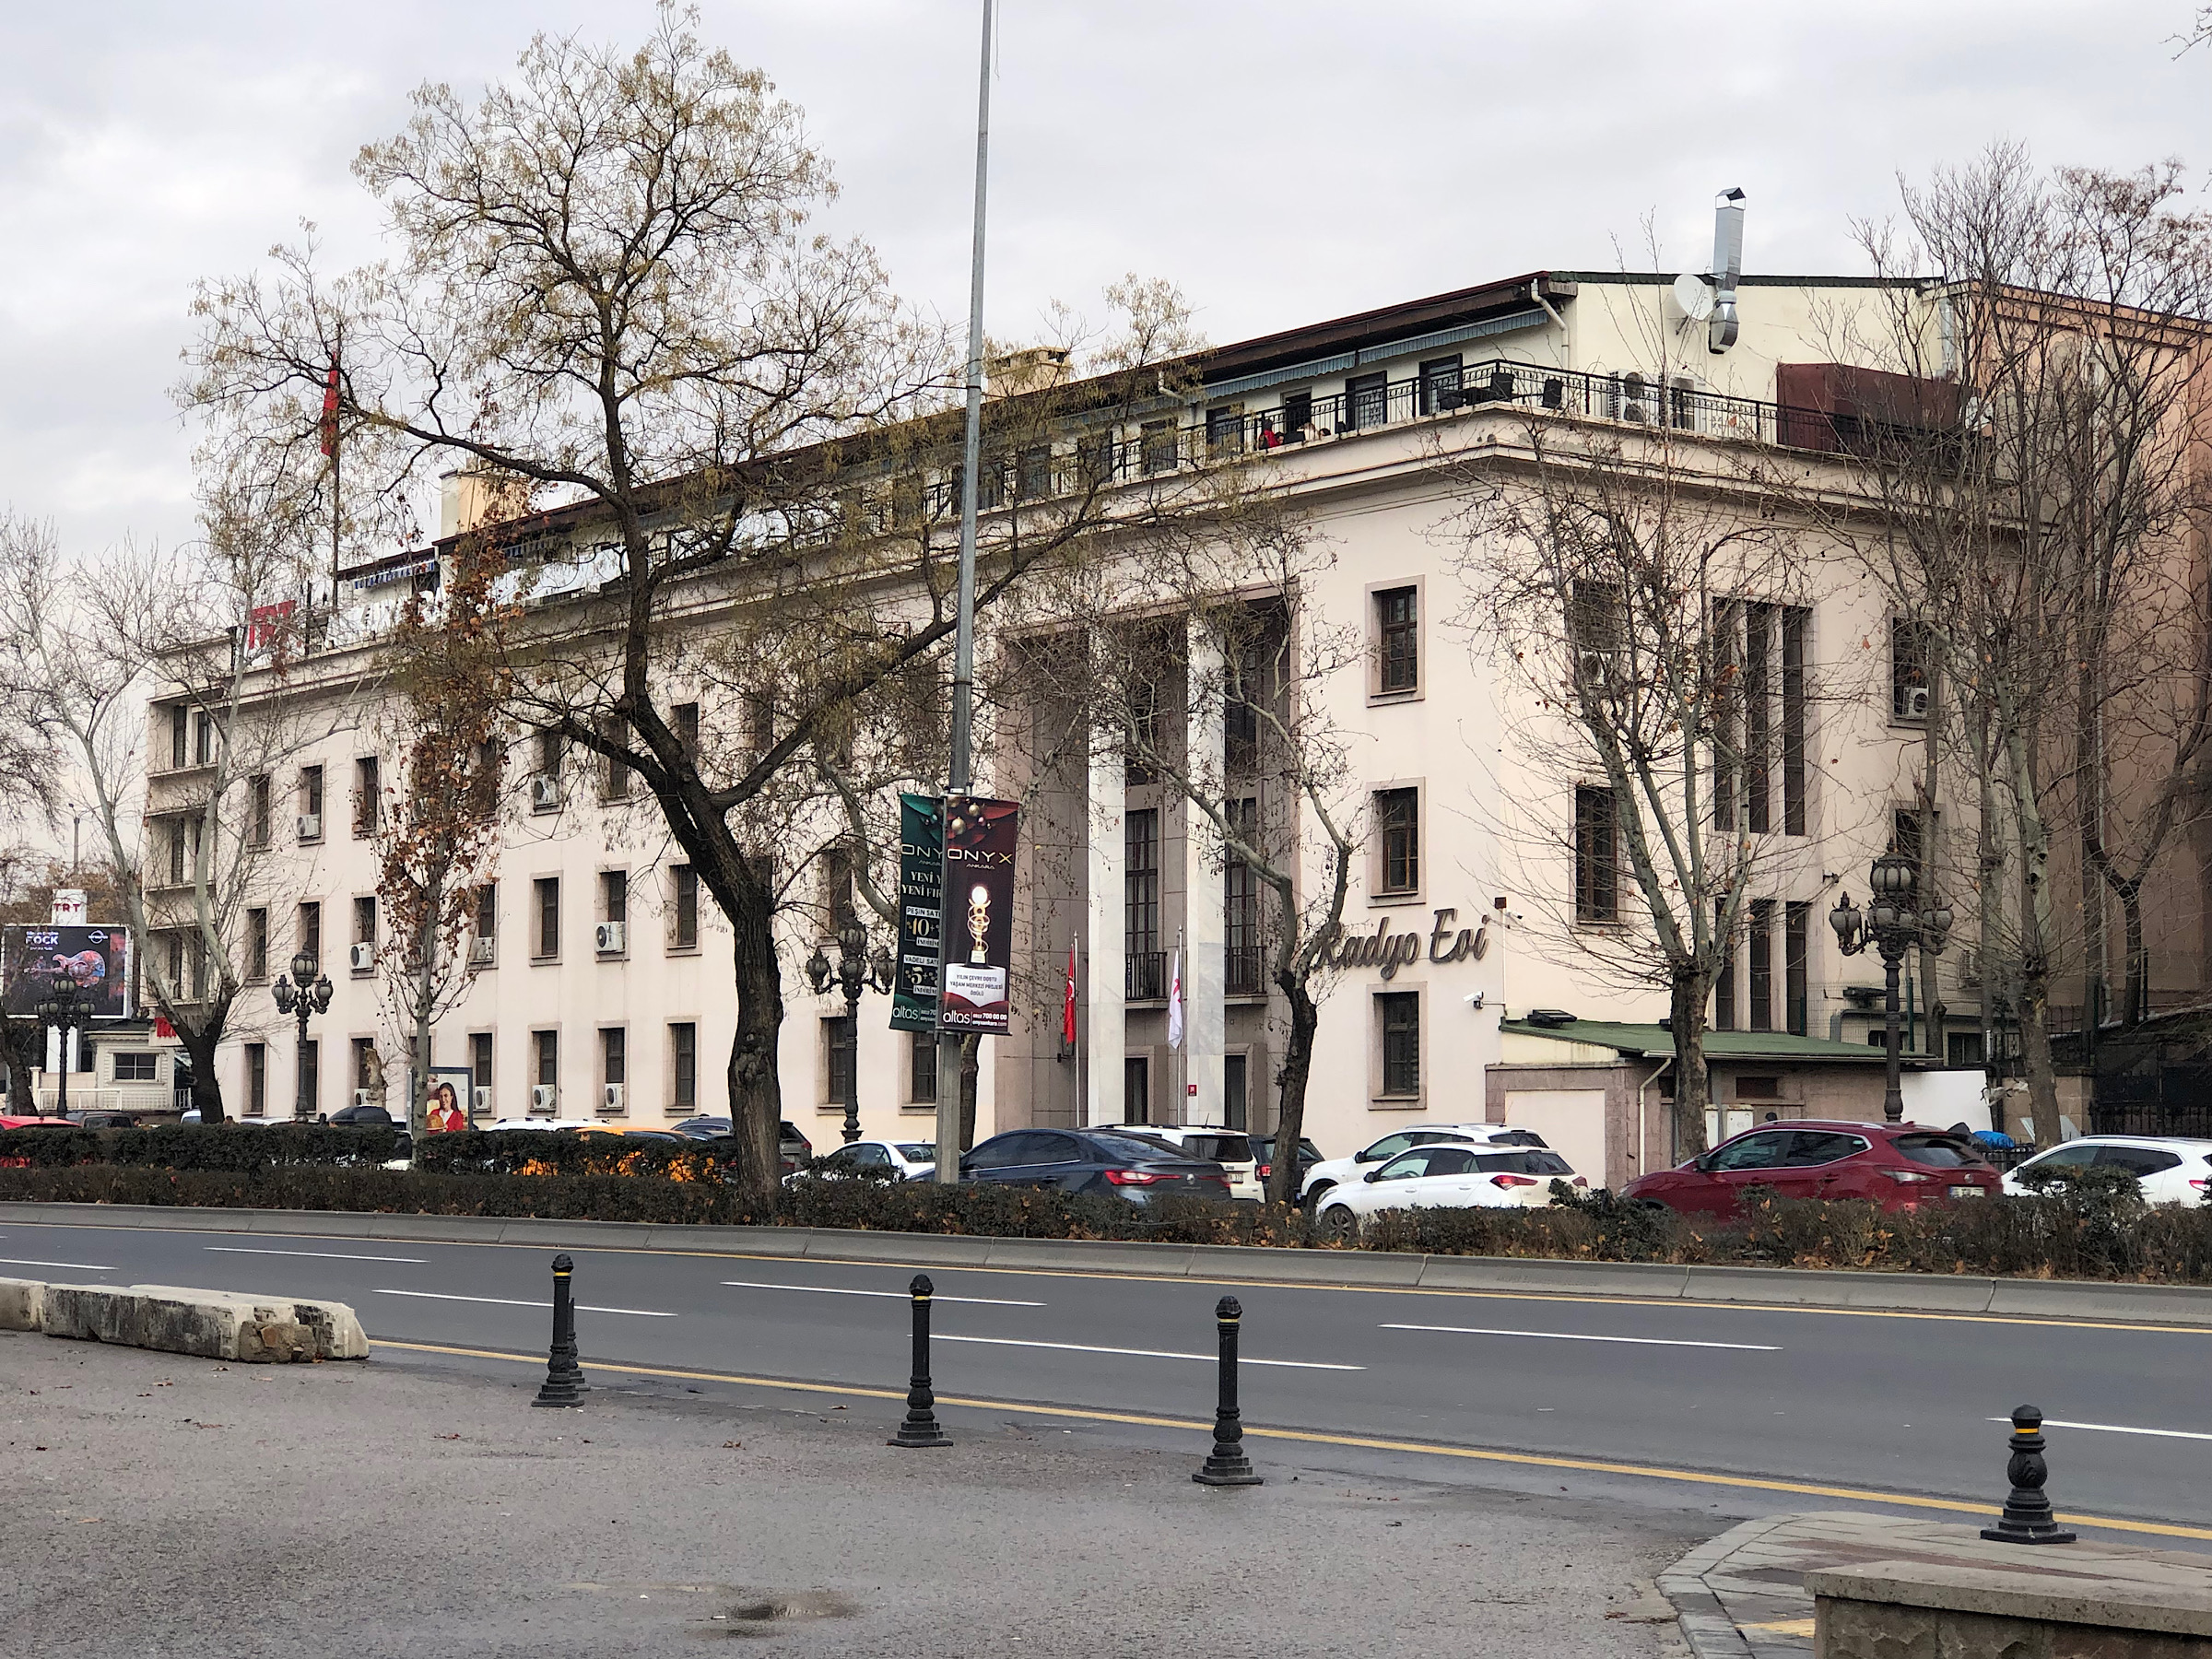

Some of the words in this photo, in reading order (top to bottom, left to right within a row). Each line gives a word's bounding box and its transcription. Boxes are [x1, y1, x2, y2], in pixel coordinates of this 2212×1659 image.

[901, 844, 942, 859] ONY
[947, 848, 1013, 865] ONYX
[911, 870, 933, 884] YENİ
[901, 884, 924, 896] YENİ
[53, 903, 81, 912] TRT
[1429, 907, 1489, 964] Evi
